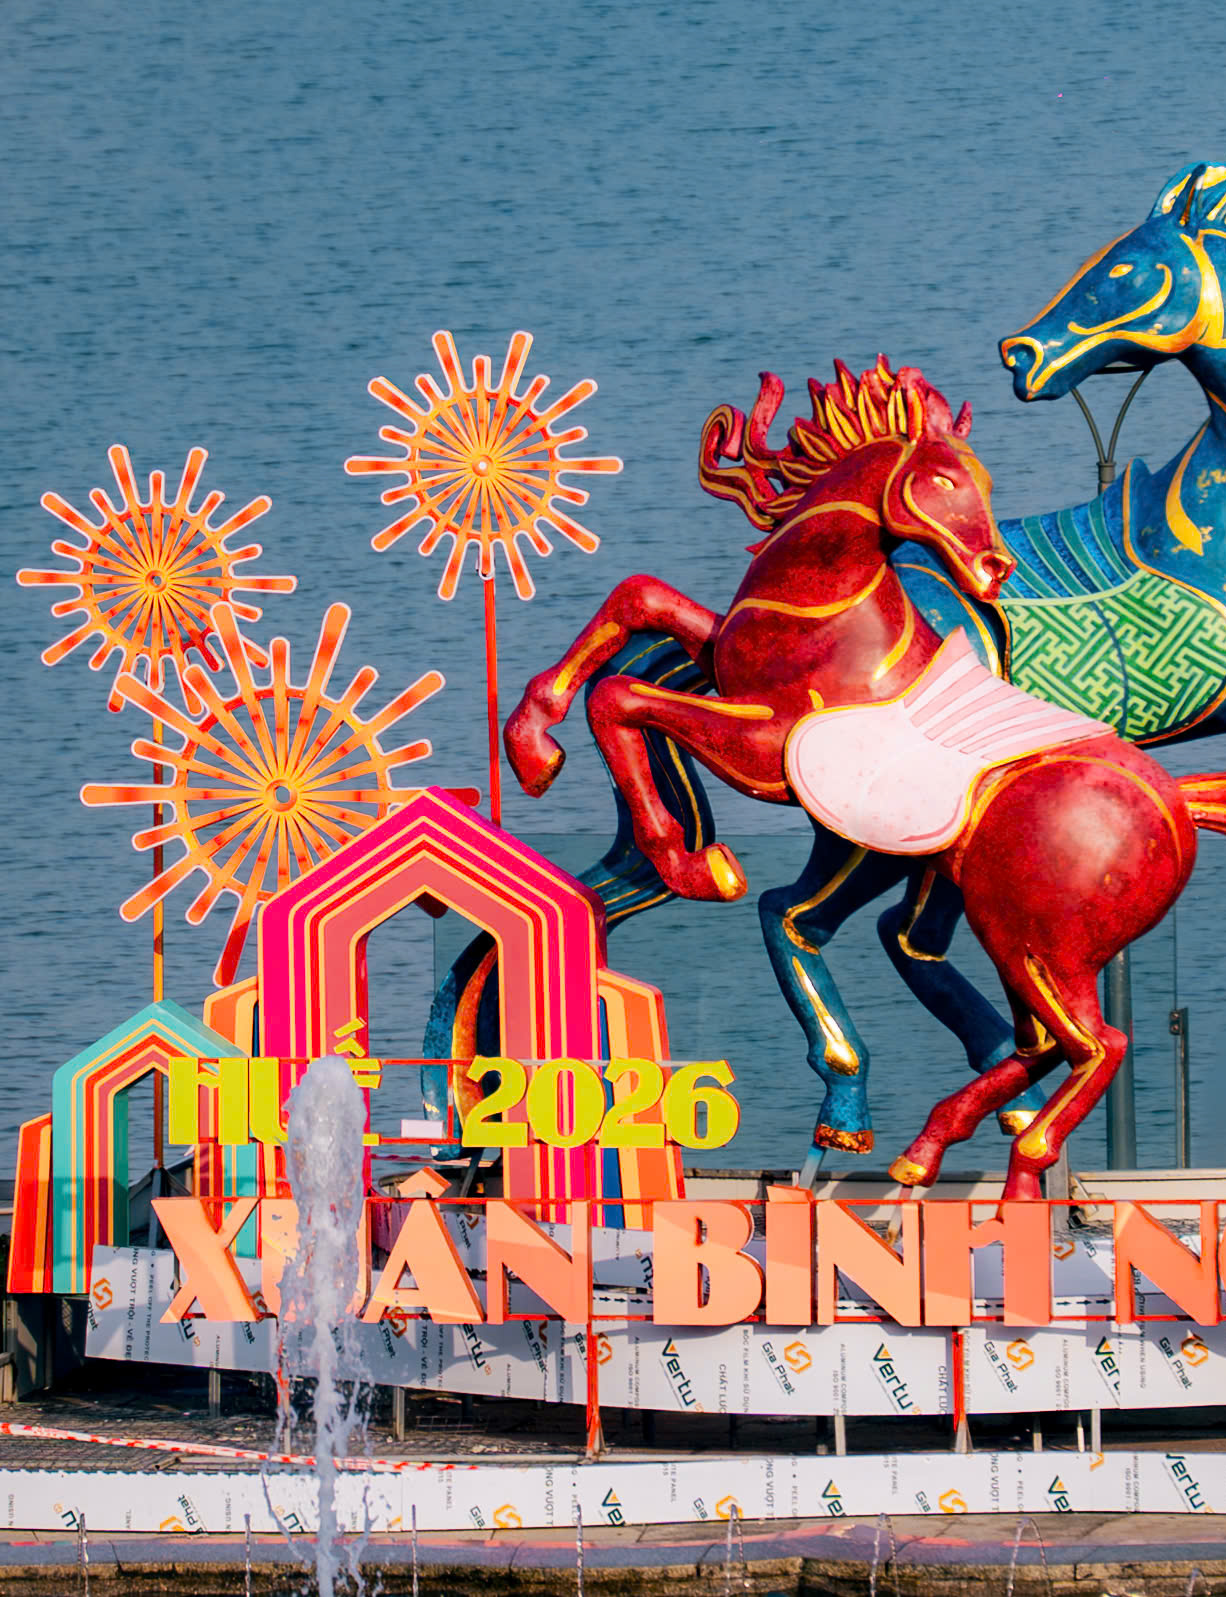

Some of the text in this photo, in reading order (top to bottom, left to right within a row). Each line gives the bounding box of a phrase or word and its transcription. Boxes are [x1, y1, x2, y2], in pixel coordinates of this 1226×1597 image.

[461, 1055, 741, 1150] 2026
[462, 1323, 486, 1368] ertu
[762, 1341, 796, 1396] Gia Phat
[984, 1341, 1018, 1394] Gia Phat
[1159, 1336, 1193, 1390] Gia Phat
[660, 1337, 696, 1407] Vertu
[718, 1364, 727, 1390] CHẤT
[873, 1342, 914, 1410] Vertu
[177, 1494, 198, 1526] Phat
[470, 1506, 485, 1528] Gia
[693, 1498, 708, 1519] Gia
[915, 1491, 931, 1512] Gia
